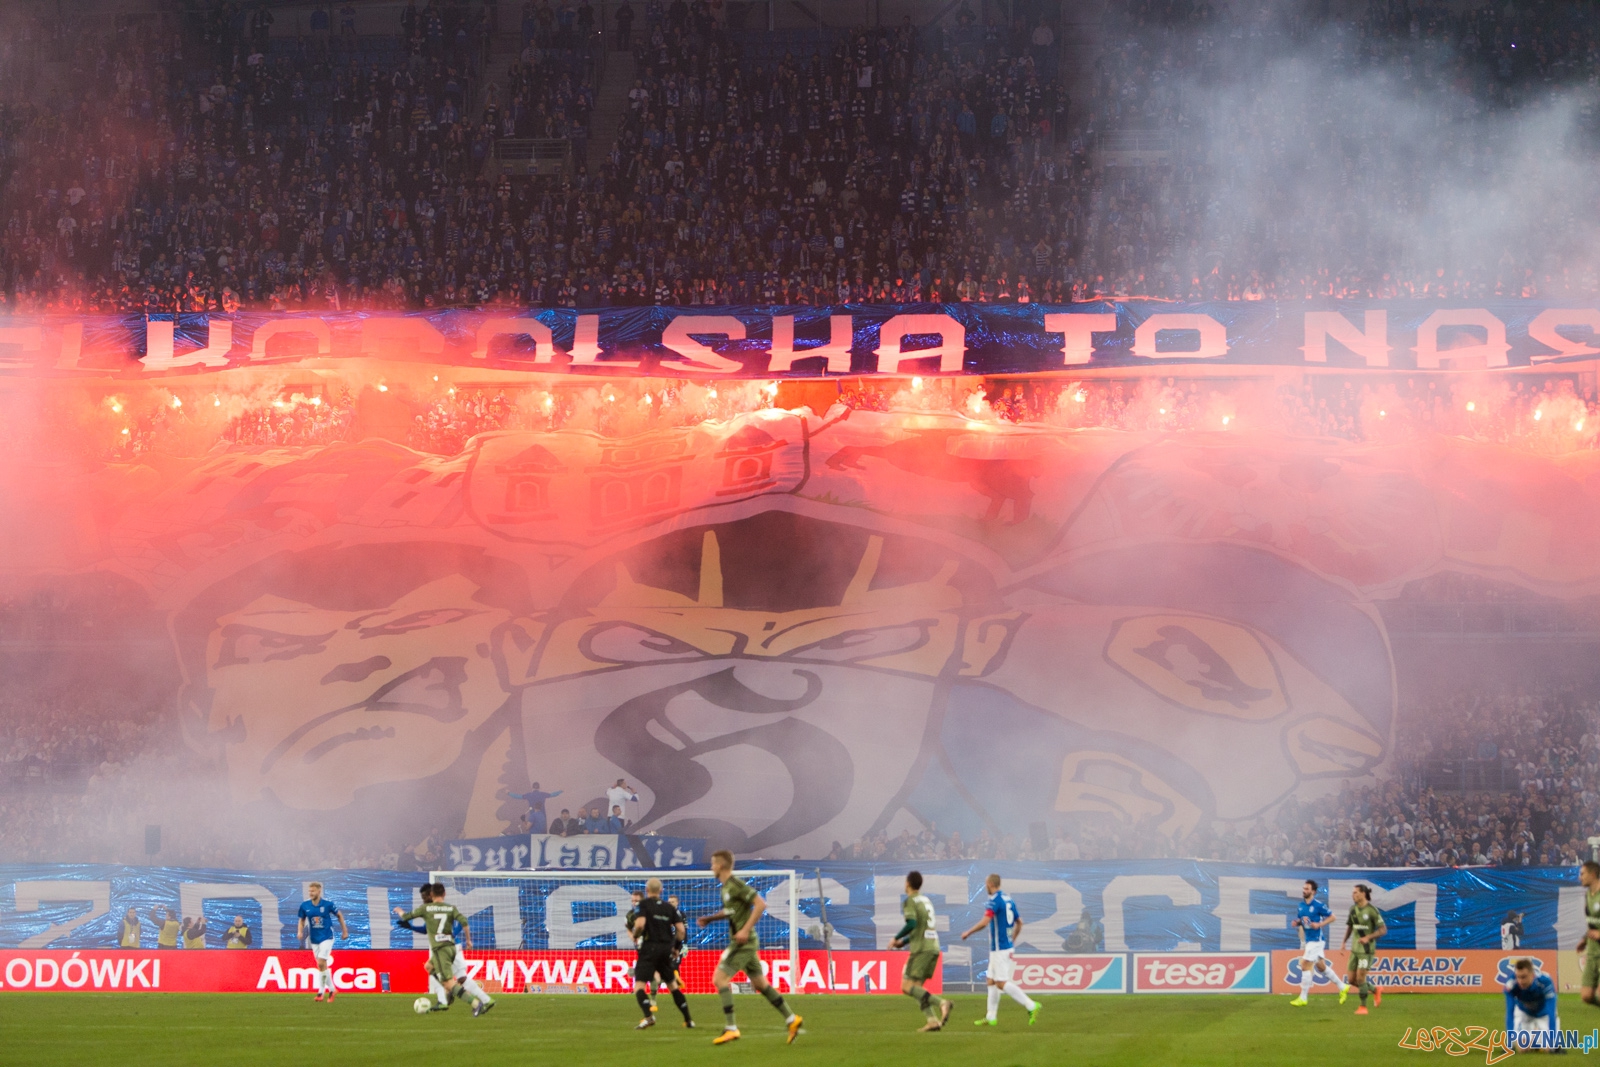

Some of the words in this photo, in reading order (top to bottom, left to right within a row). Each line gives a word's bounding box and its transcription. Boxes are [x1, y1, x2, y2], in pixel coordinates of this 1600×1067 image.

[1045, 313, 1231, 365] TO
[433, 913, 448, 934] 7
[0, 951, 160, 988] ODÓWKI
[1144, 961, 1226, 986] tesa
[1343, 975, 1482, 986] KMACHERSKIE
